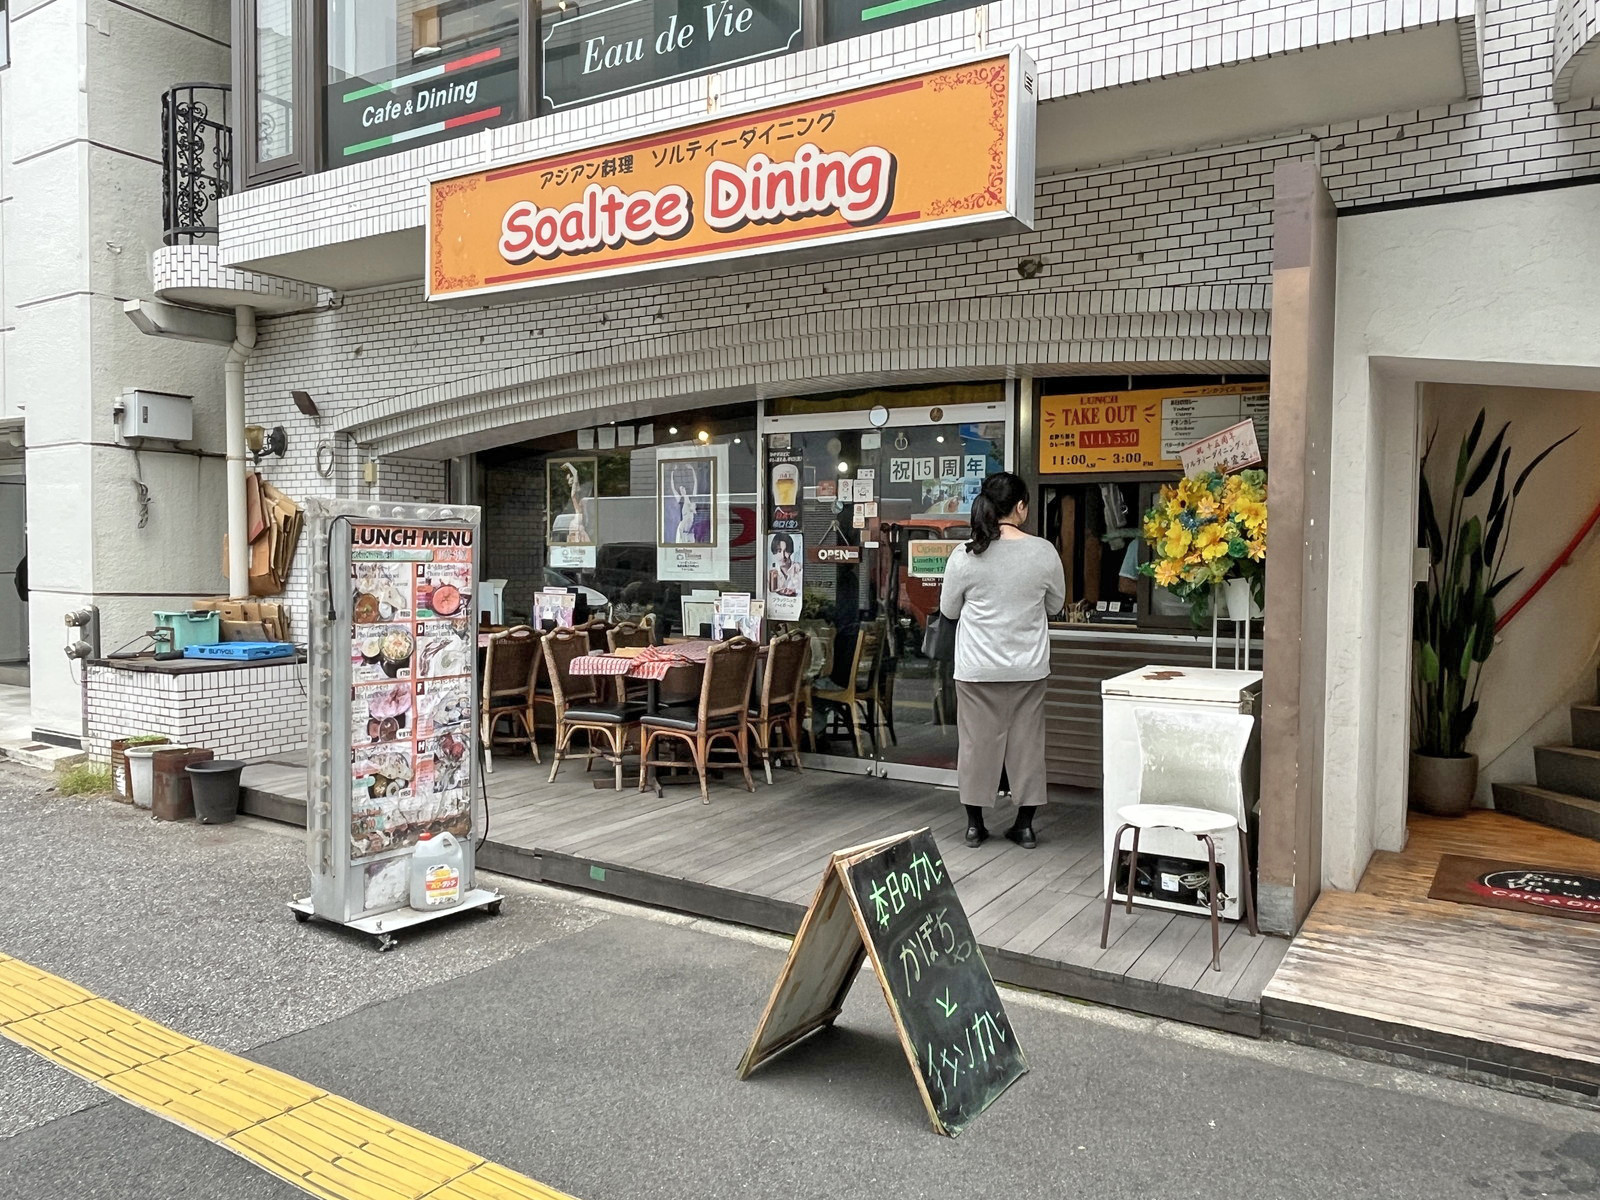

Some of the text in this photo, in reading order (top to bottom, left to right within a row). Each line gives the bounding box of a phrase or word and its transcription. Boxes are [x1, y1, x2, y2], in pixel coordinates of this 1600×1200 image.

[582, 0, 753, 75] Eau de Vie
[362, 80, 478, 127] Cafe & Dining
[541, 111, 836, 190] アジアン料理 ソルティーダイニング
[501, 148, 888, 257] Soaltee Dining
[1080, 395, 1118, 405] LUNCH
[1062, 405, 1137, 426] TAKE OUT
[1052, 454, 1086, 465] 11:00
[1113, 453, 1141, 464] 3:00
[350, 528, 473, 547] LUNCH MENU
[818, 549, 849, 560] OPEN
